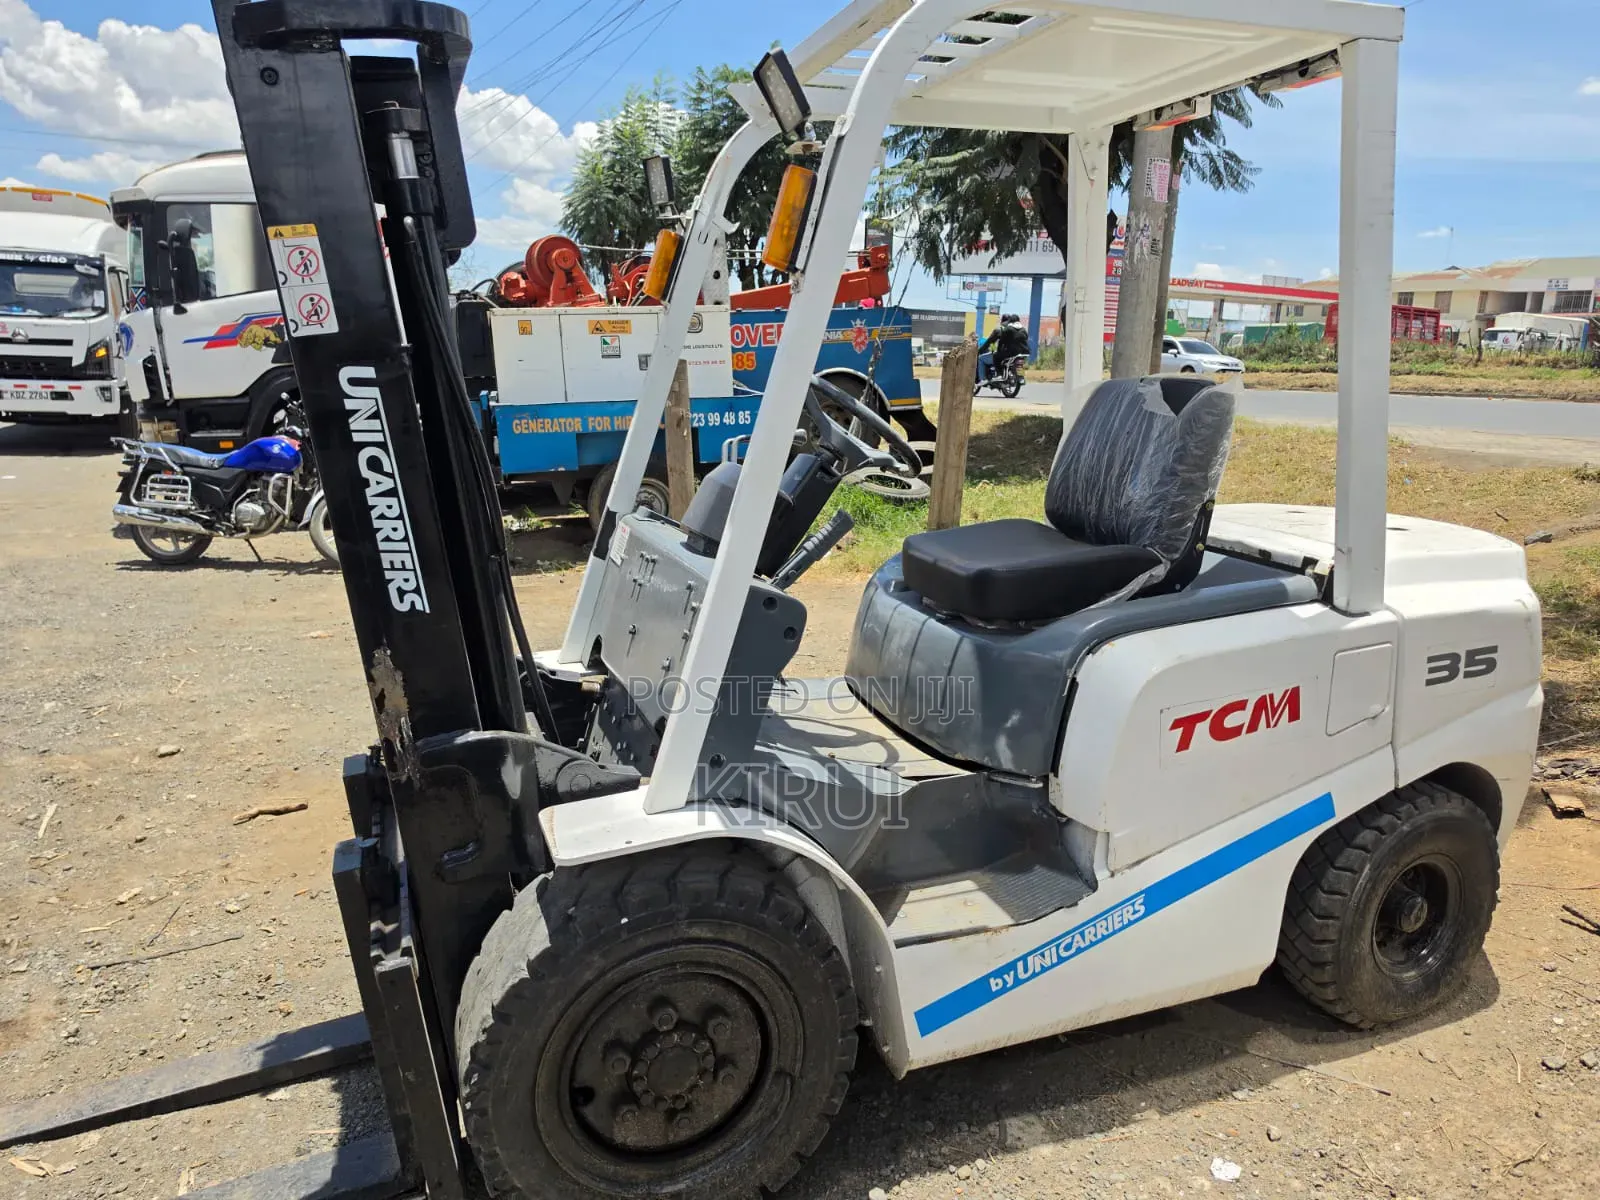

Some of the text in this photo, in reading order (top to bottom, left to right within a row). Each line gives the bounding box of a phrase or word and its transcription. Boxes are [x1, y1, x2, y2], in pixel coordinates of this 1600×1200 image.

[731, 351, 756, 371] 85
[512, 416, 582, 434] GENERATOR
[587, 416, 611, 432] FOR
[707, 411, 720, 426] 99
[723, 411, 736, 425] 48
[738, 410, 751, 425] 85
[338, 365, 430, 614] UNICARRIERS
[1425, 645, 1499, 687] 35
[1168, 685, 1301, 753] TCM
[989, 893, 1146, 993] by UNICARRIERS
